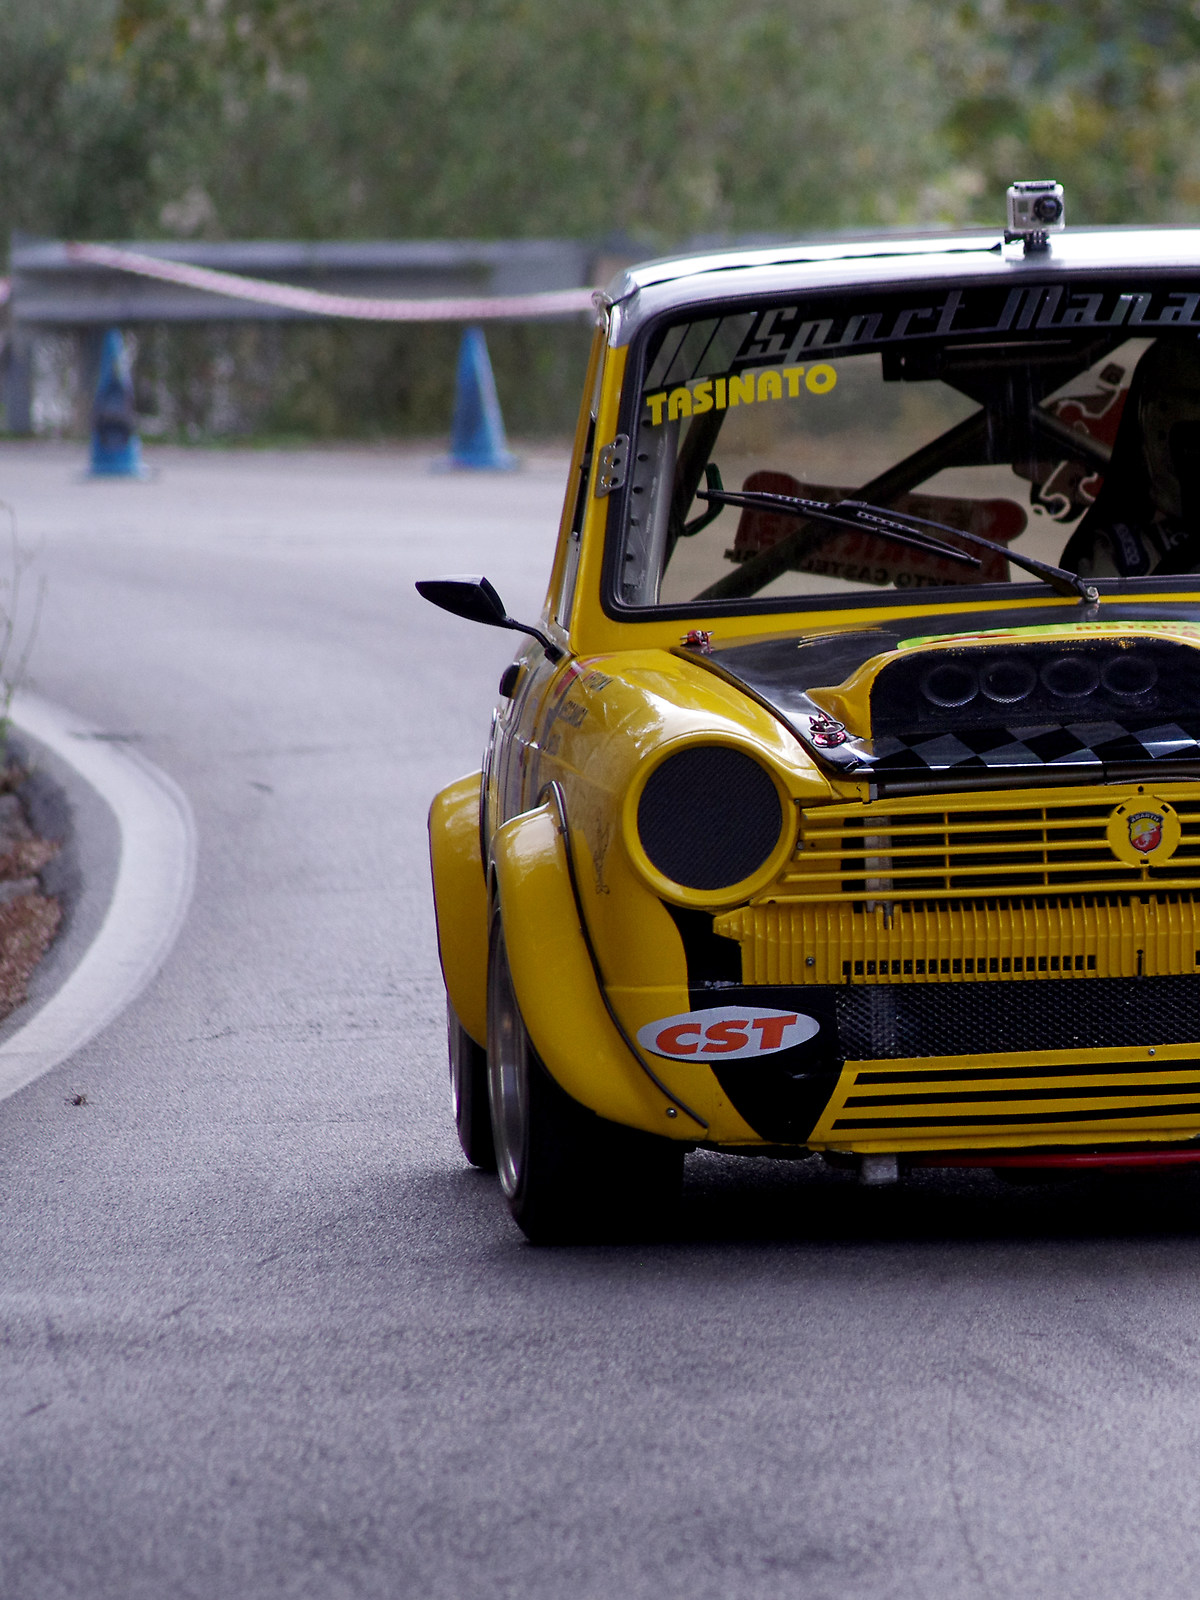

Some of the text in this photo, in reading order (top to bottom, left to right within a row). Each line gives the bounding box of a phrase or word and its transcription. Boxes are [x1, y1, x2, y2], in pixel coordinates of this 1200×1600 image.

[736, 290, 965, 364] Sport
[646, 363, 838, 427] TASINATO
[1131, 812, 1160, 823] ABARTH
[655, 1014, 798, 1055] CST
